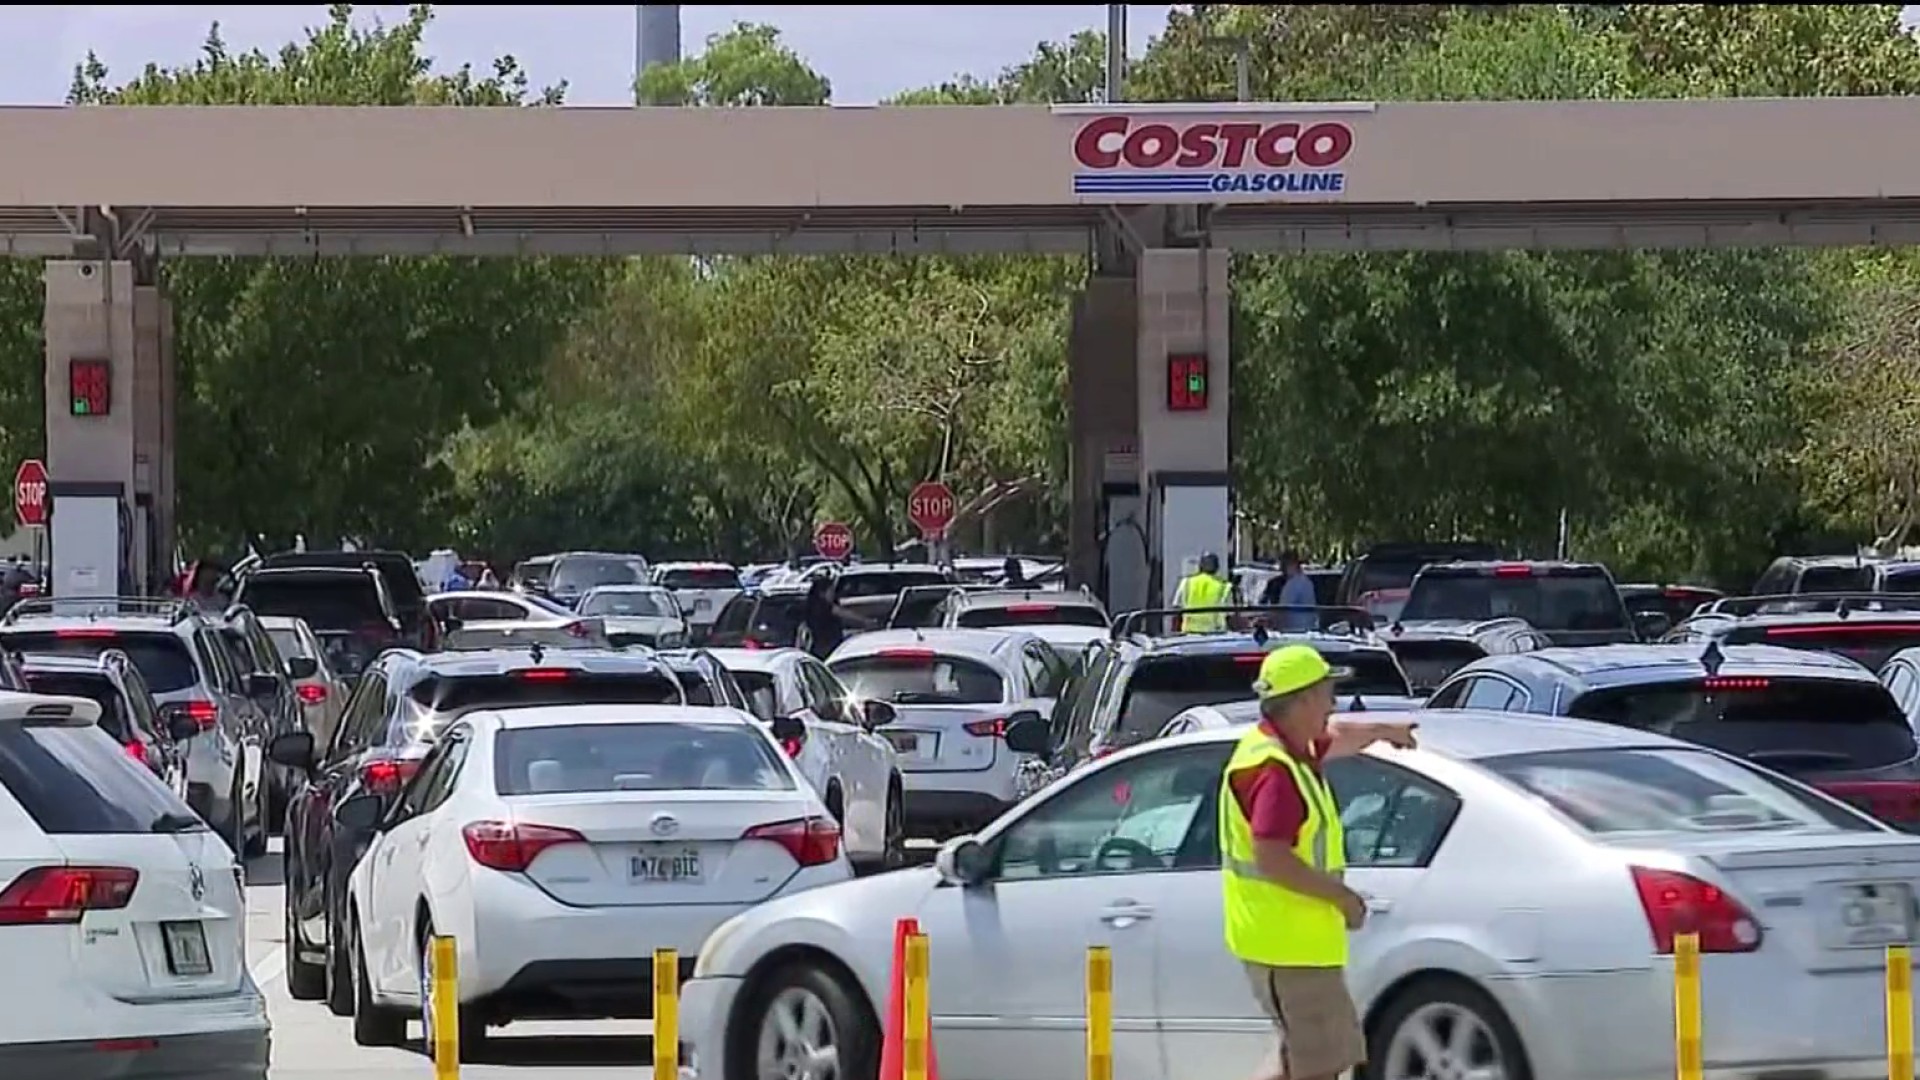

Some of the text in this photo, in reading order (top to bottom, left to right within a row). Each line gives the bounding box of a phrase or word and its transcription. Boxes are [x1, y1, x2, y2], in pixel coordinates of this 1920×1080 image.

[1074, 116, 1353, 168] COSTCO
[1211, 173, 1344, 192] GASOLINE
[18, 481, 47, 506] STOP
[911, 497, 953, 516] STOP
[819, 533, 849, 548] STOP
